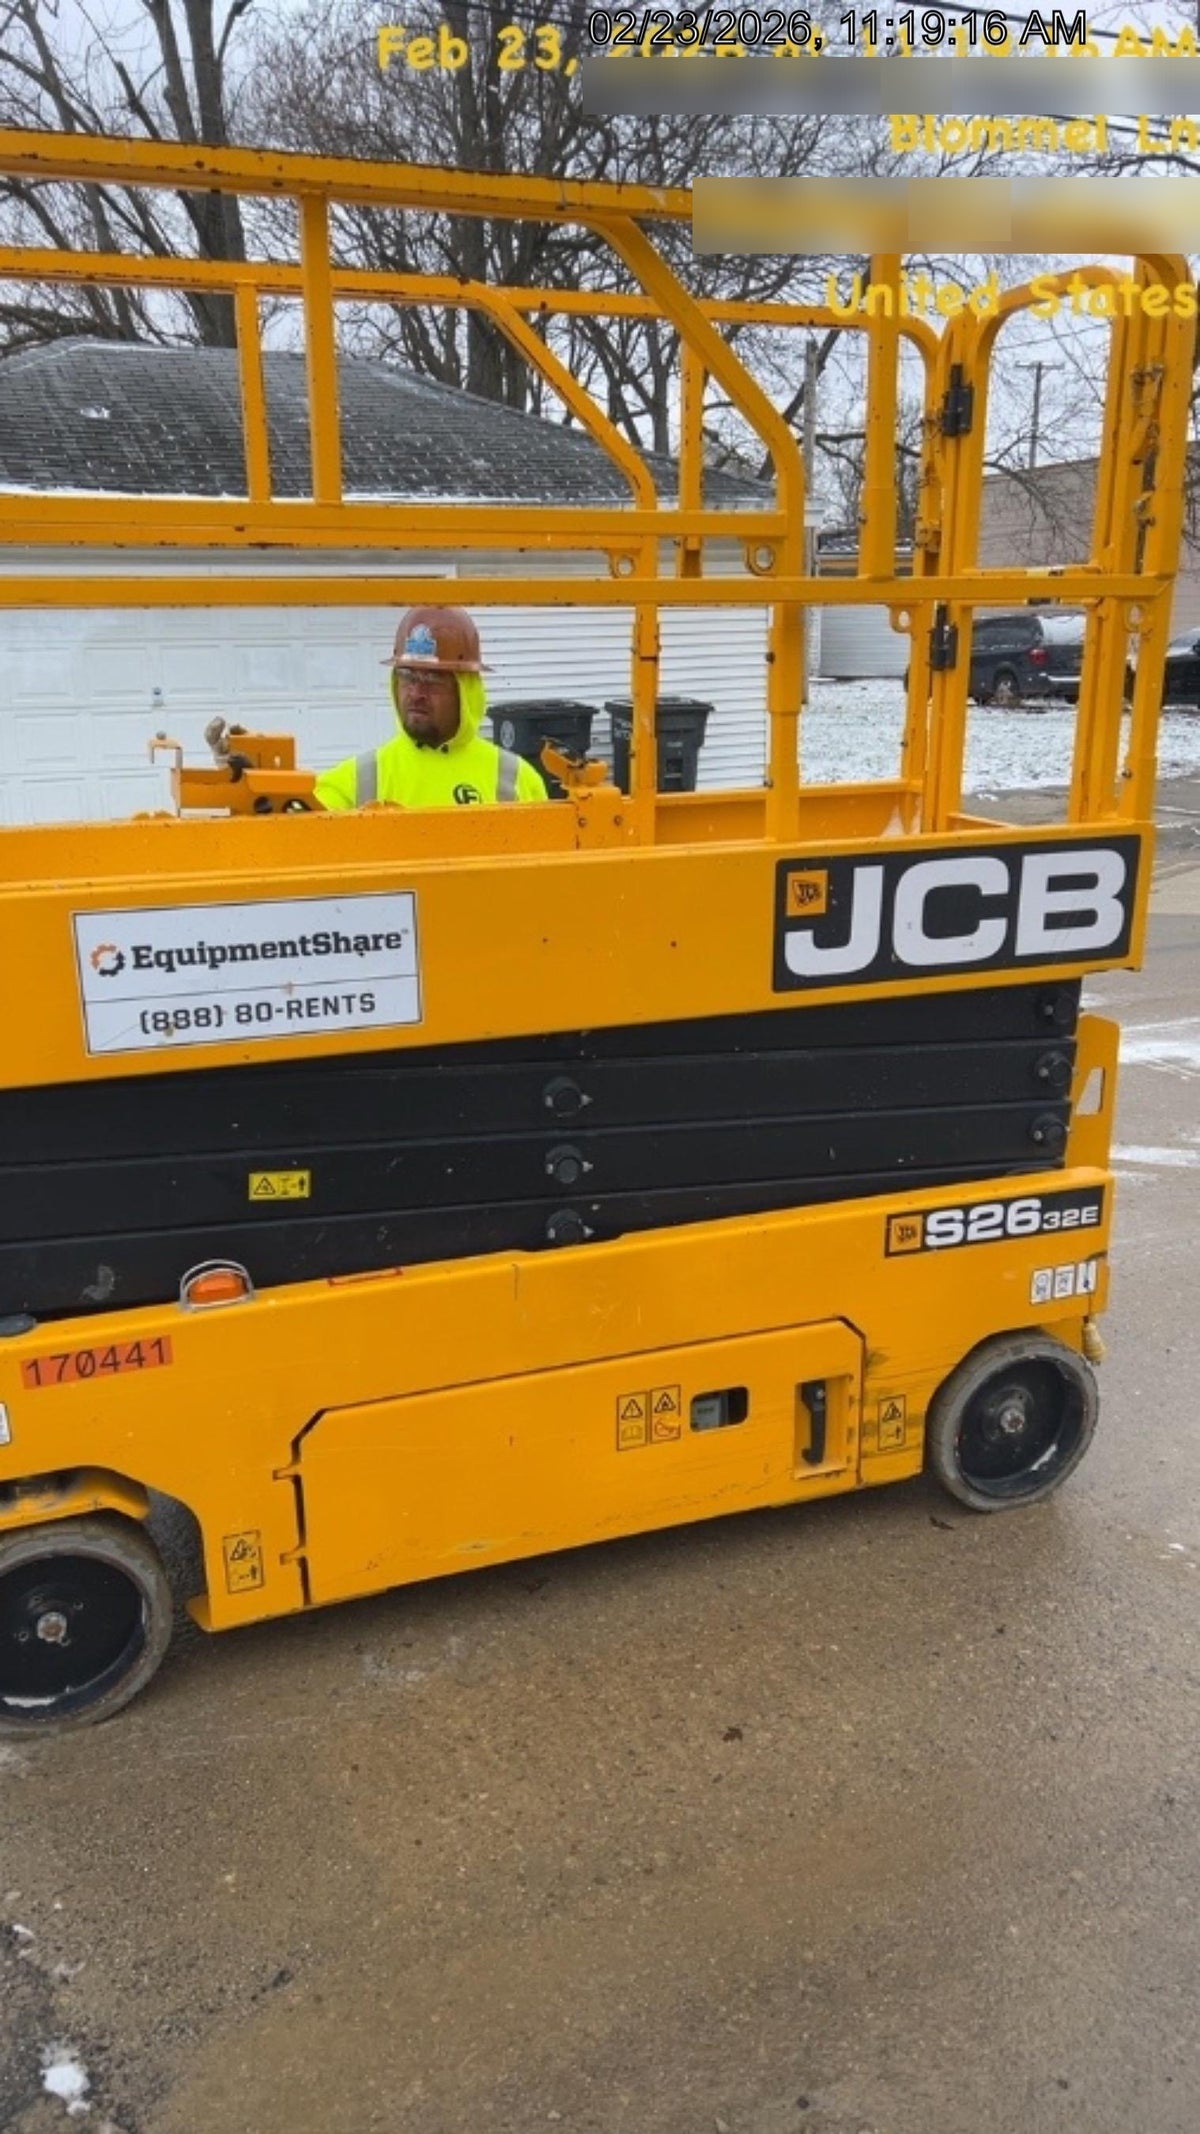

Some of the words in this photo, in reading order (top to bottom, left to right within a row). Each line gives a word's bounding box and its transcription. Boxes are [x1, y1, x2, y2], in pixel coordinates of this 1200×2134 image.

[784, 848, 1127, 977] JCB
[132, 930, 402, 973] EquipmentShare
[139, 1004, 224, 1034] (888)
[235, 993, 376, 1024] 80-RENTS
[25, 1337, 168, 1386] 170441
